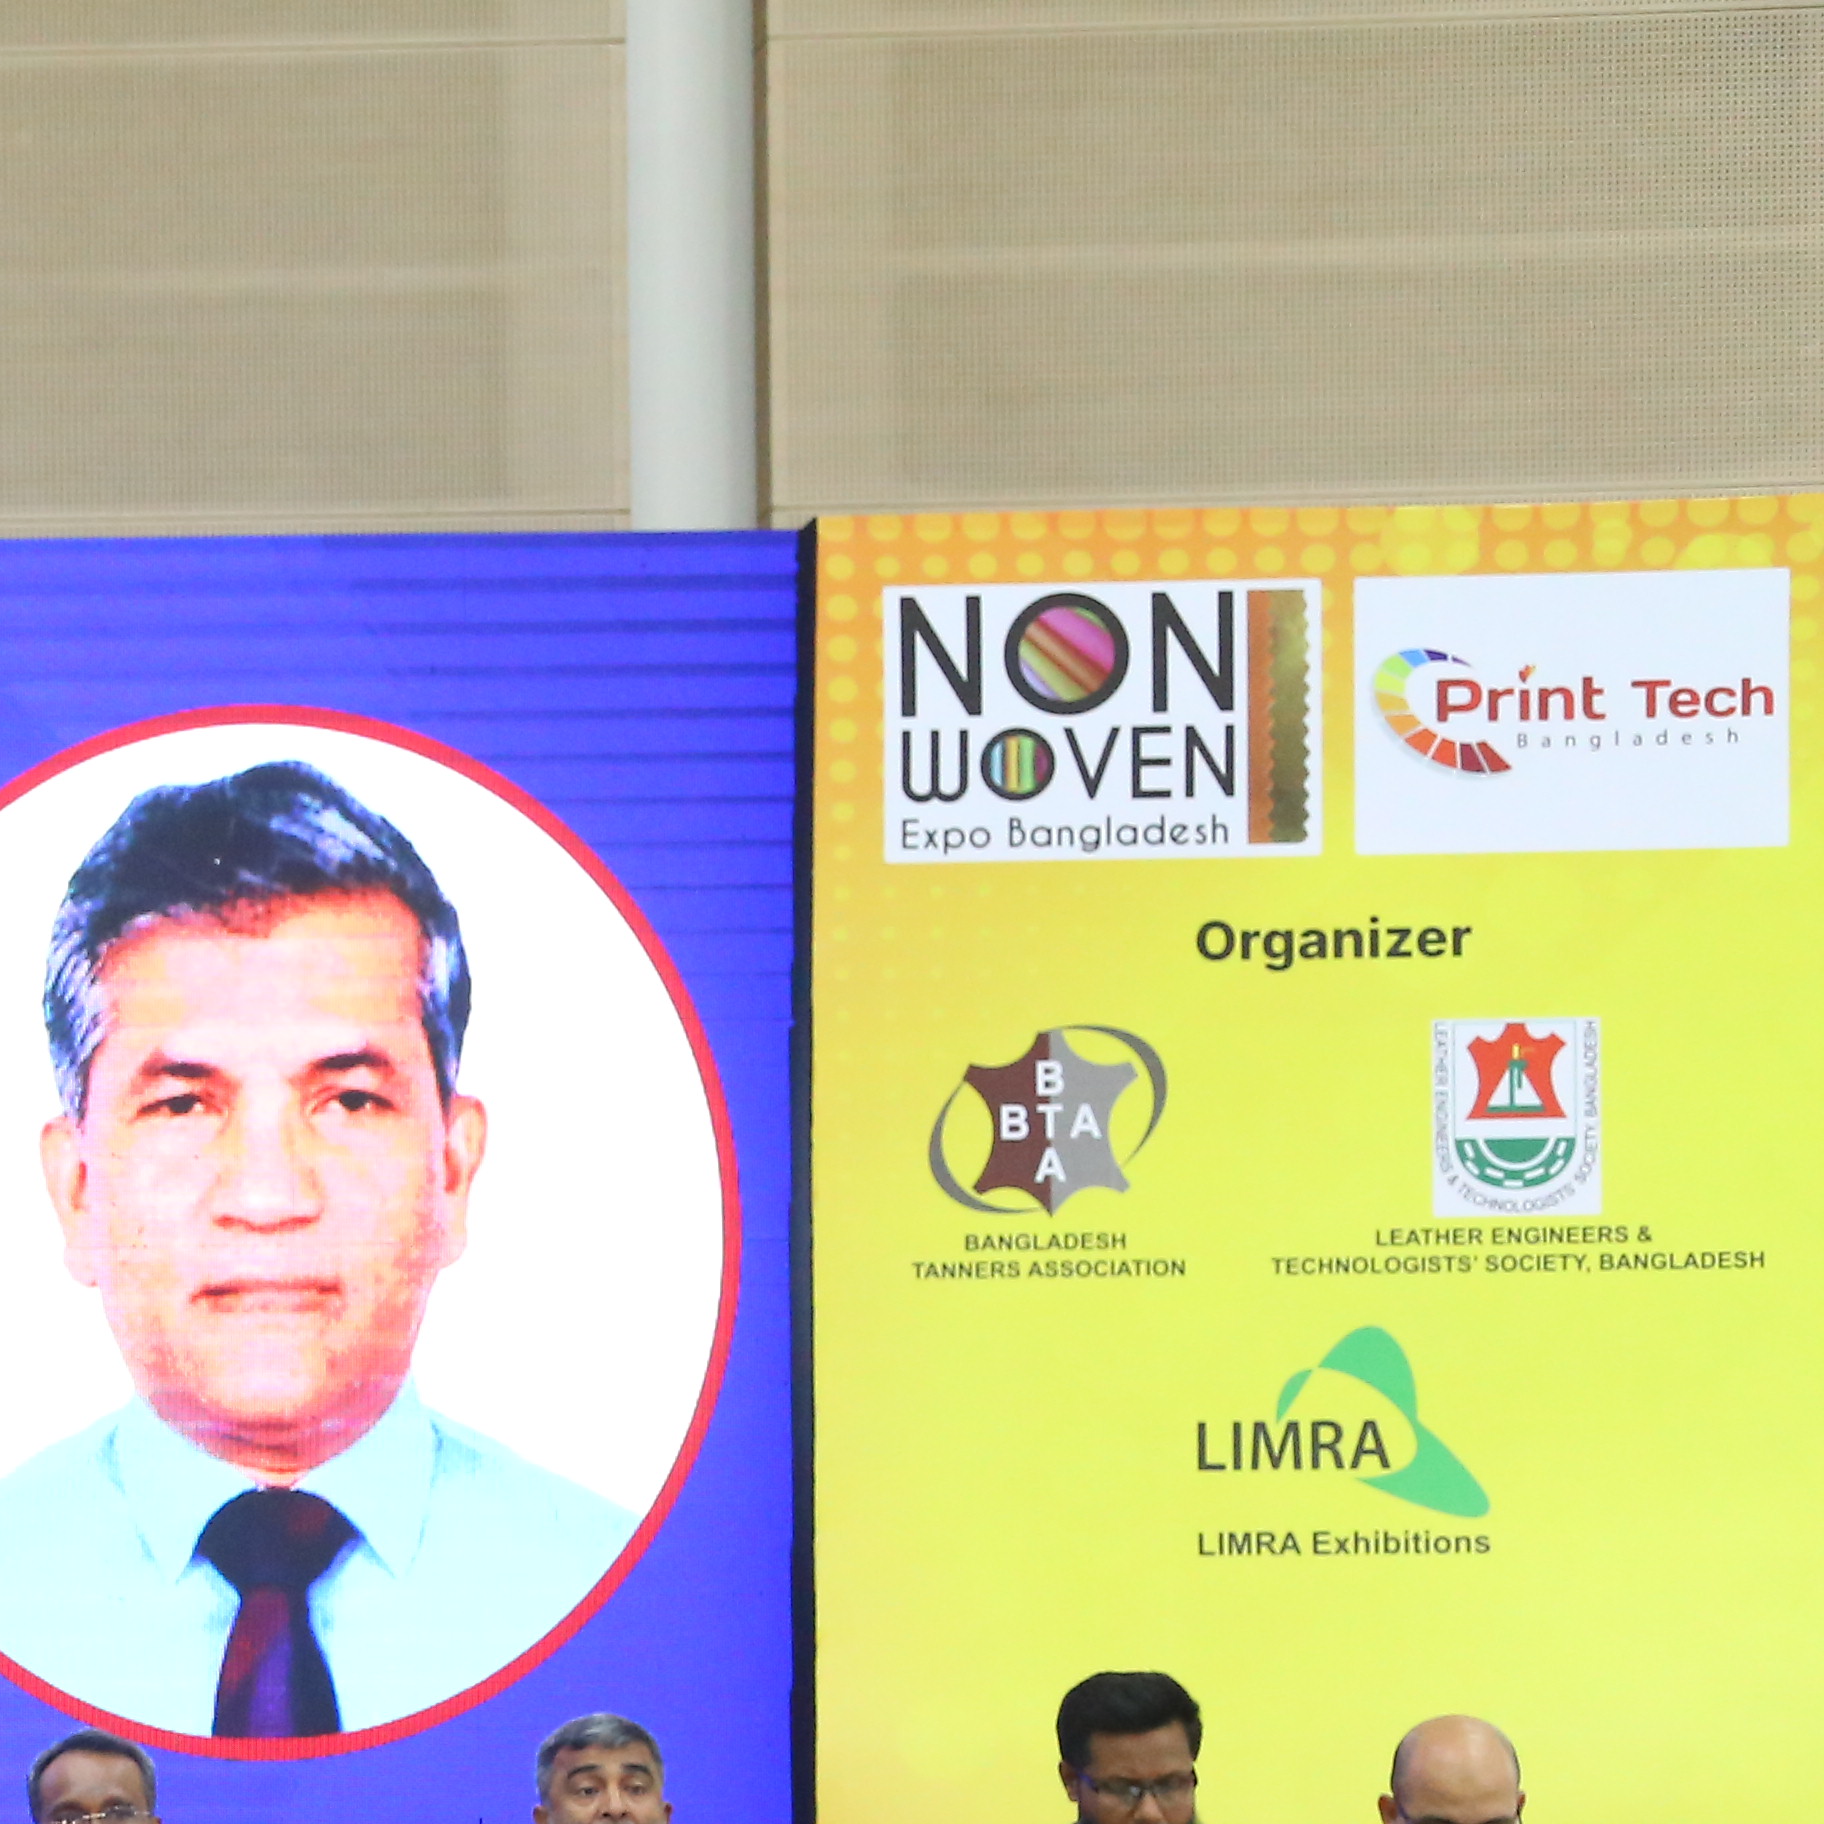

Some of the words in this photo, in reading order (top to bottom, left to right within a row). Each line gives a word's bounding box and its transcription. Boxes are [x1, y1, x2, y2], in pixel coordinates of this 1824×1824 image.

[900, 591, 1234, 717] NON
[1436, 664, 1606, 722] Print
[1631, 677, 1775, 719] Tech
[1517, 728, 1739, 752] Bangladesh
[902, 725, 1234, 803] WOVEN
[901, 818, 992, 855] Expo
[1008, 814, 1229, 853] Bangladesh
[1196, 916, 1473, 972] Organizer
[964, 1232, 1127, 1252] BANGLADESH
[1375, 1227, 1483, 1247] LEATHER
[1491, 1225, 1629, 1245] ENGINEERS
[1636, 1225, 1653, 1243] &
[912, 1261, 1021, 1279] TANNERS
[1028, 1259, 1186, 1278] ASSOCIATION
[1271, 1255, 1478, 1276] TECHNOLOGISTS'
[1485, 1253, 1591, 1273] SOCIETY,
[1599, 1250, 1766, 1271] BANGLADESH
[1197, 1420, 1391, 1471] LIMRA
[1198, 1531, 1302, 1556] LIMRA
[1312, 1529, 1491, 1556] Exhibitions
